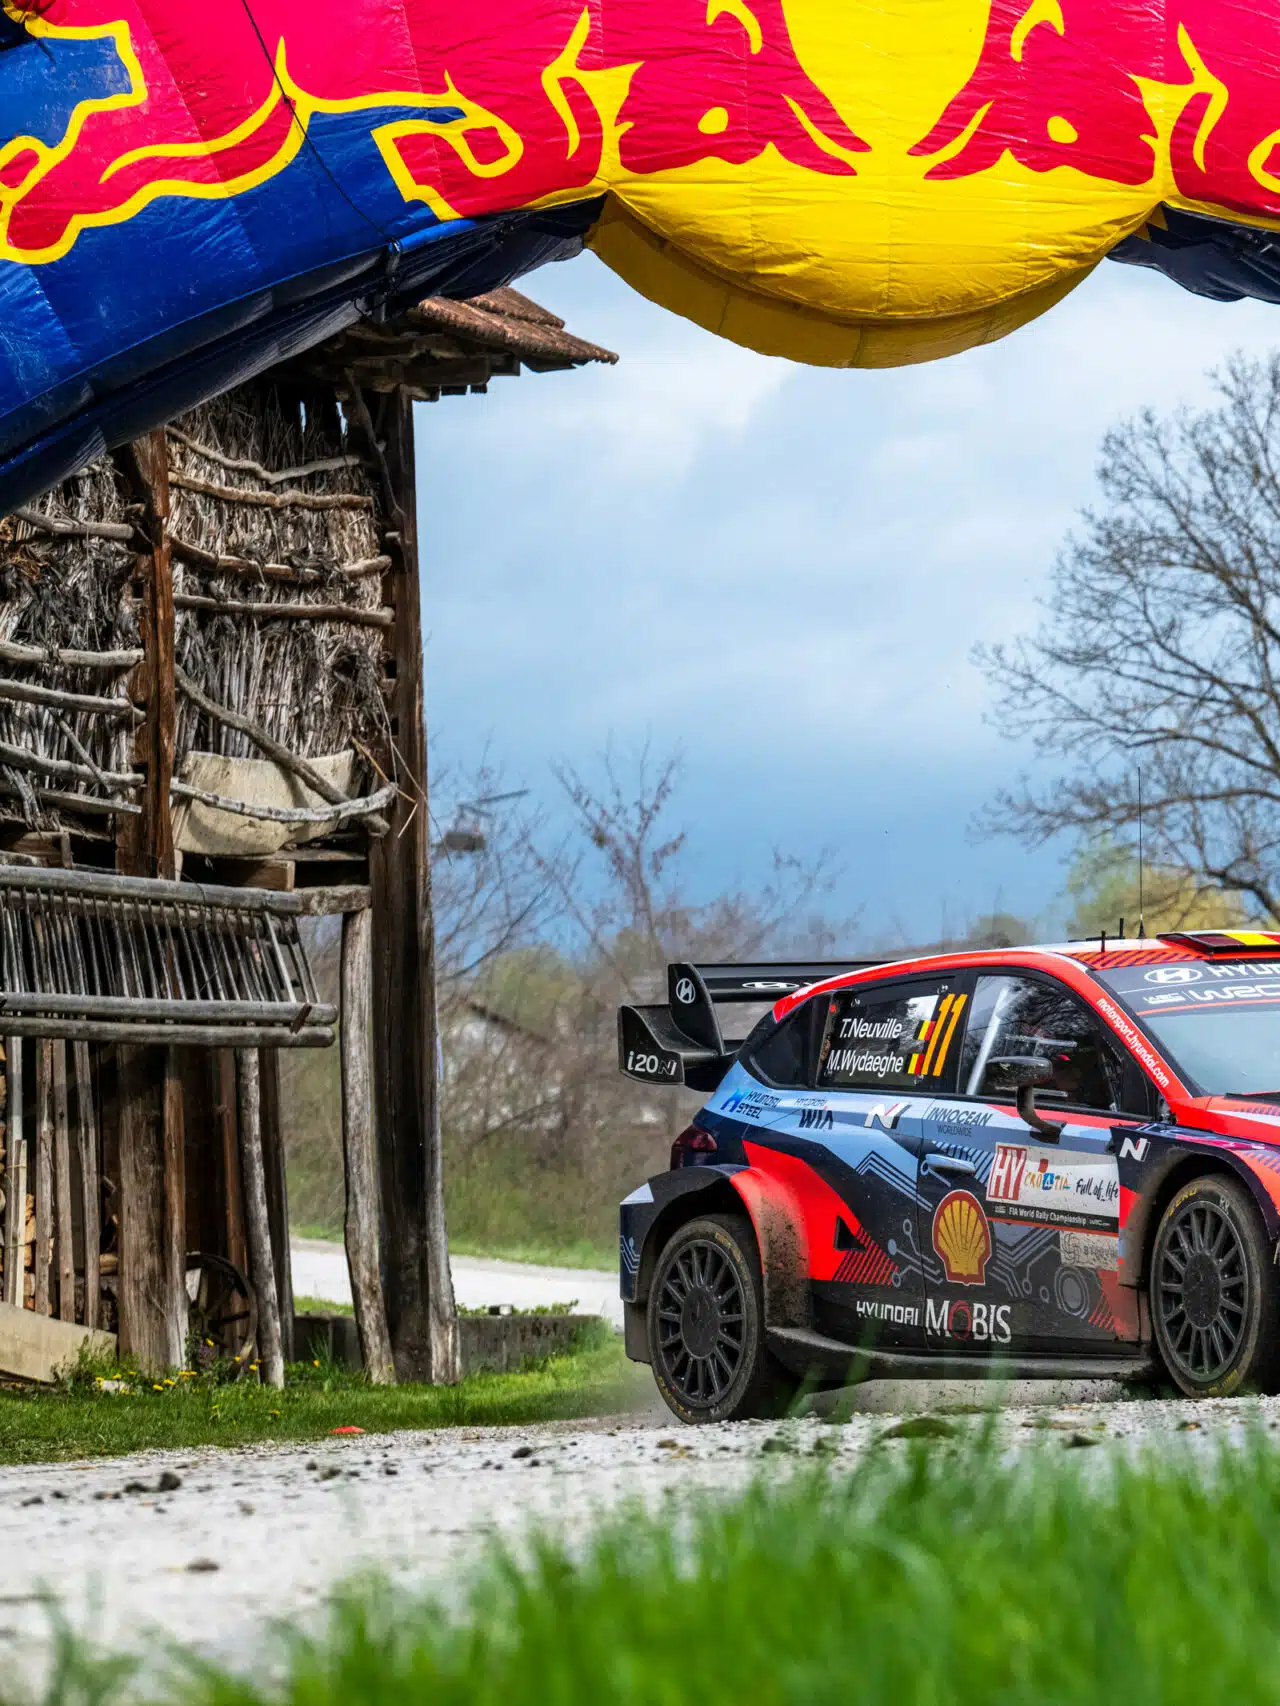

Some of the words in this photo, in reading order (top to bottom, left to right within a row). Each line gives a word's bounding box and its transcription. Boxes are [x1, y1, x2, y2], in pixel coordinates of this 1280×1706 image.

[839, 1017, 903, 1039] T.Neuville
[921, 993, 968, 1077] 11
[1096, 998, 1170, 1088] motorsport.hyundai.com
[826, 1049, 904, 1078] M.Wydaeghe
[745, 1090, 782, 1108] HYUNDAI
[736, 1103, 762, 1119] STEEL
[798, 1106, 834, 1129] WIA
[927, 1107, 993, 1127] INNOCEAN
[937, 1126, 972, 1137] WORLDWIDE
[1023, 1171, 1071, 1191] CROATIA
[1019, 1208, 1035, 1218] World
[1036, 1210, 1049, 1222] Rally
[1050, 1212, 1087, 1227] Championship
[856, 1300, 919, 1327] HYUNDAI
[926, 1298, 1012, 1344] MOBIS
